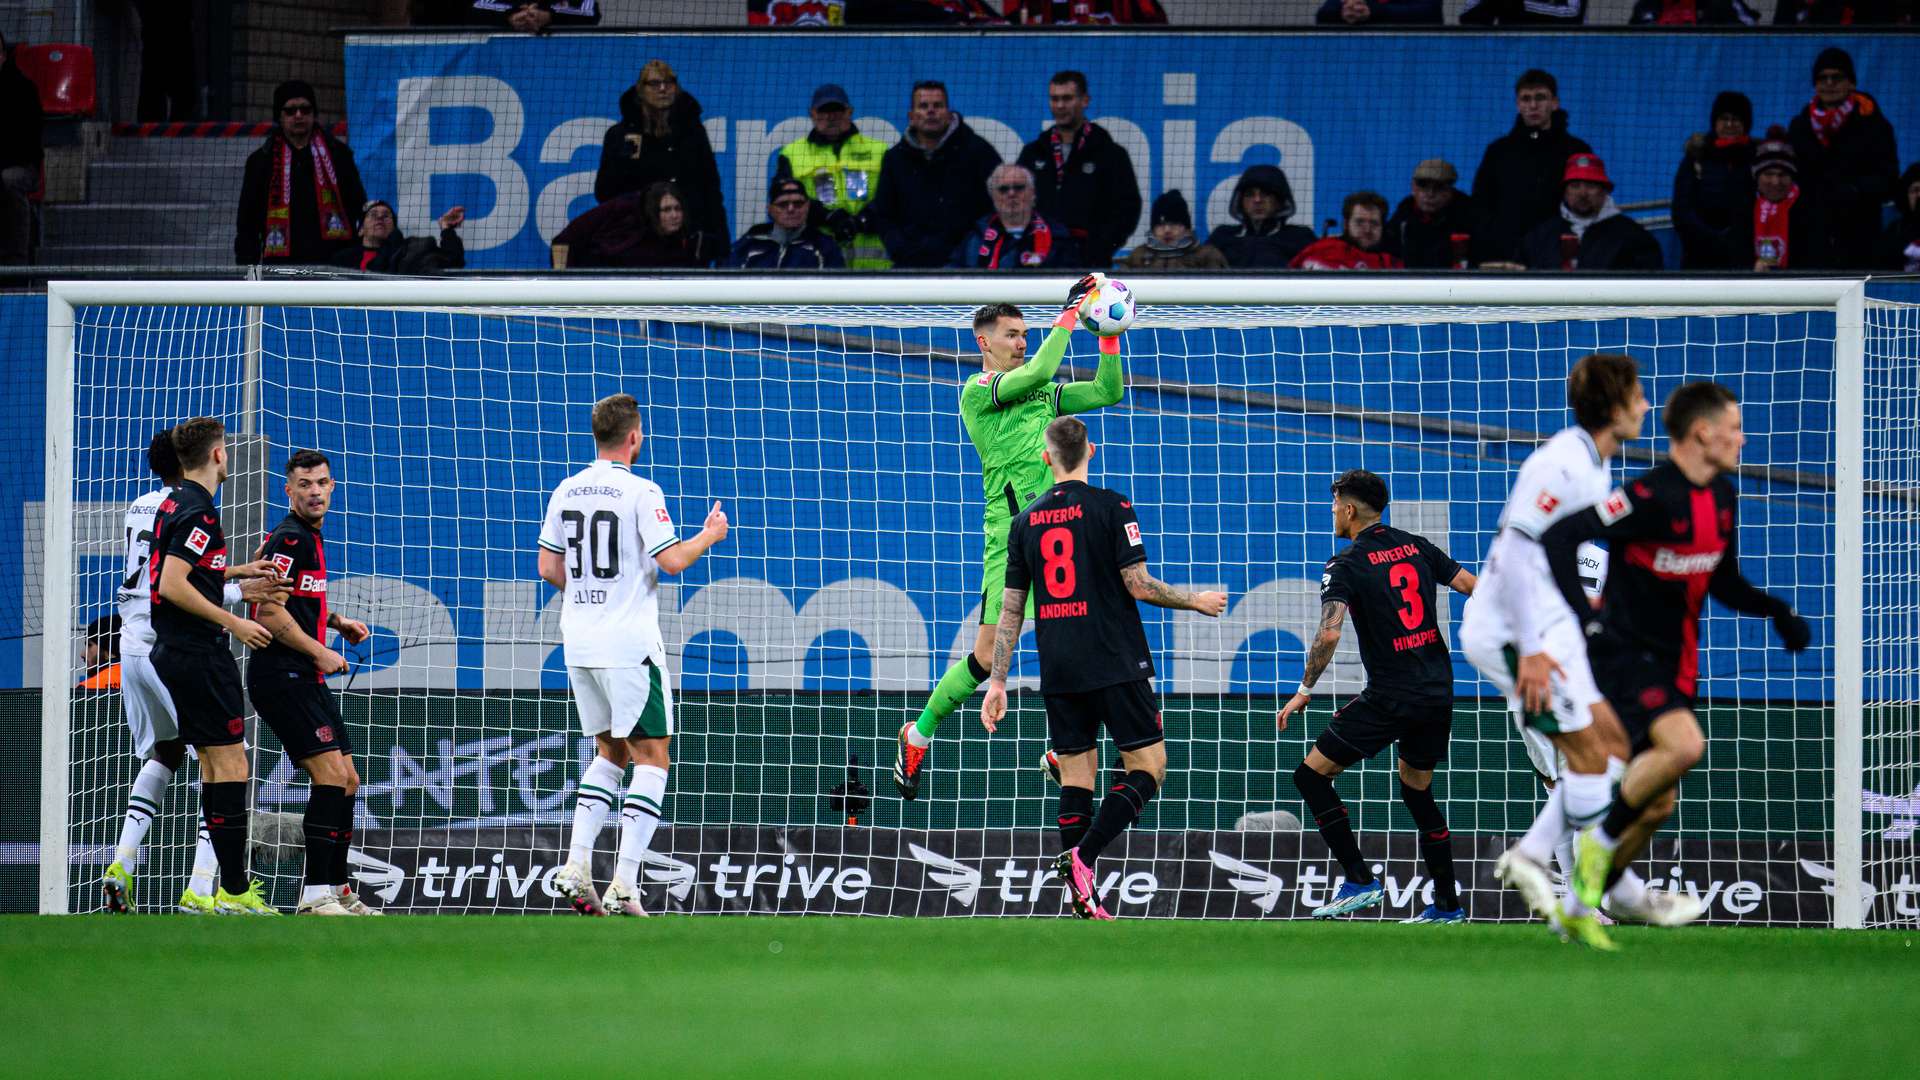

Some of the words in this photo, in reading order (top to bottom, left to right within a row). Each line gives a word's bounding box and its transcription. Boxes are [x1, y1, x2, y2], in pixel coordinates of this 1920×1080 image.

[560, 509, 622, 580] 30
[1040, 527, 1077, 599] 8
[1040, 601, 1088, 619] ANDRICH
[1389, 562, 1424, 630] 3
[709, 854, 872, 901] trive
[995, 860, 1158, 905] trve
[1297, 863, 1462, 908] tve
